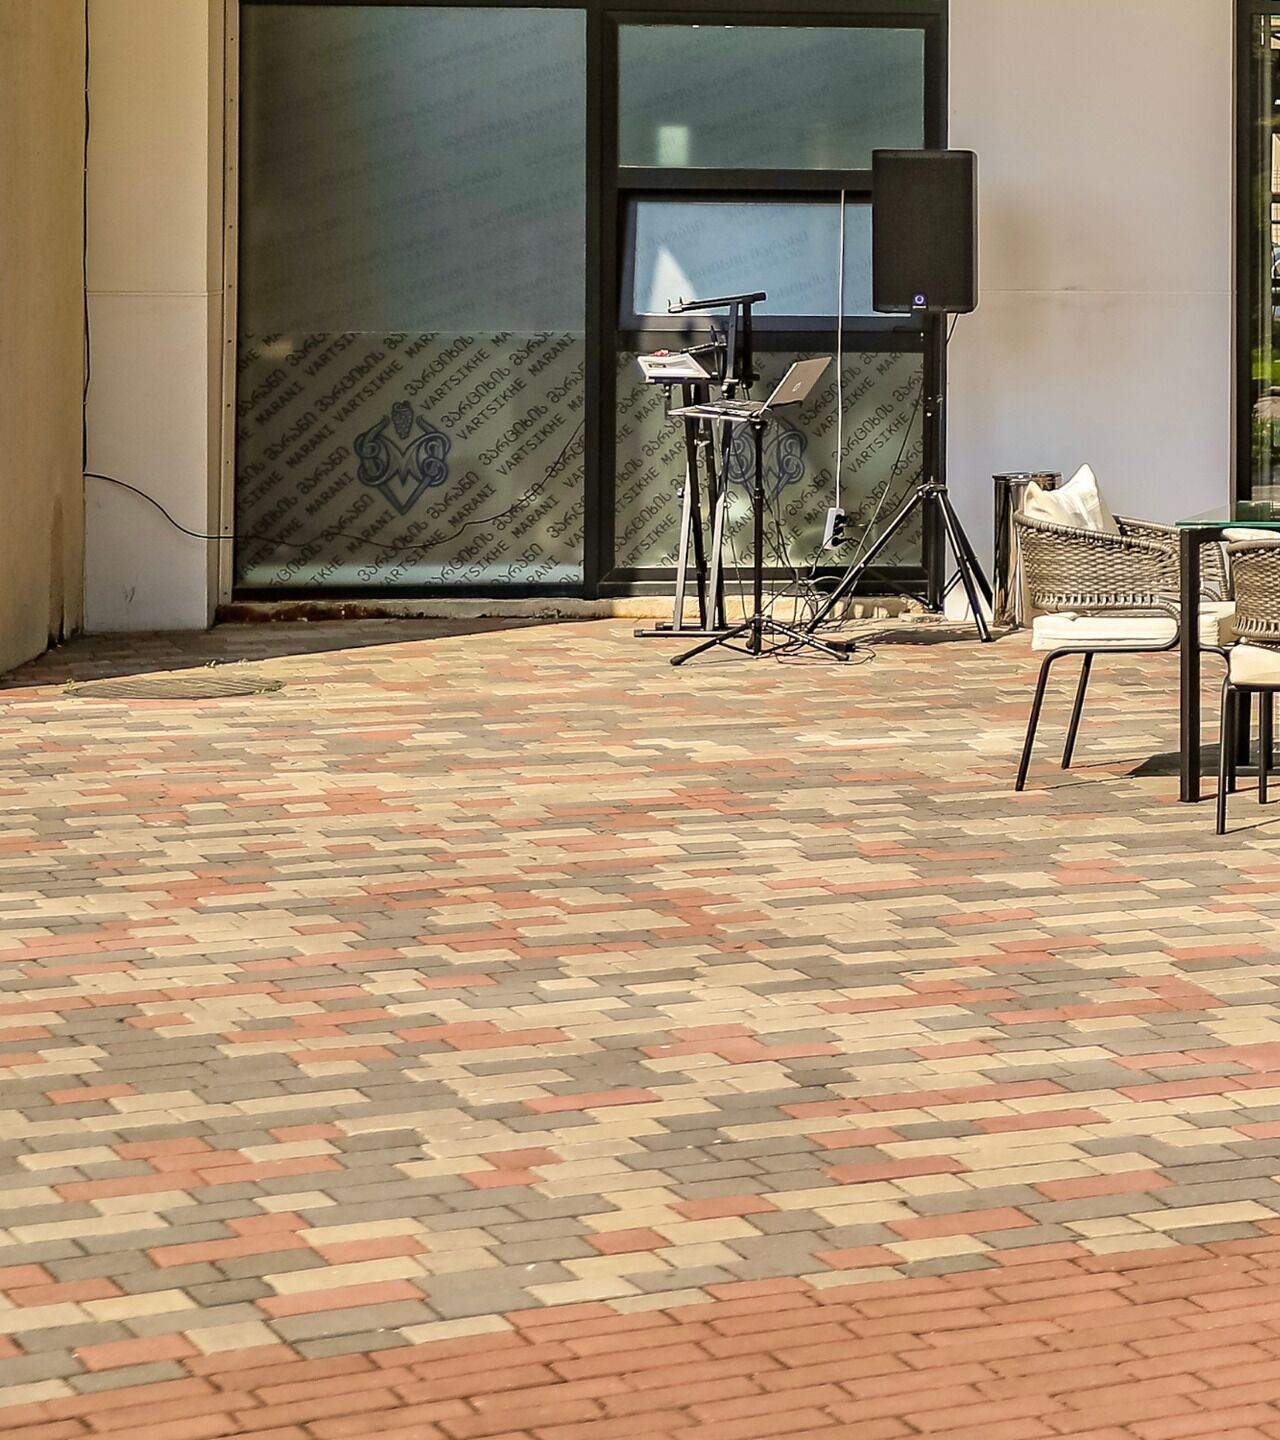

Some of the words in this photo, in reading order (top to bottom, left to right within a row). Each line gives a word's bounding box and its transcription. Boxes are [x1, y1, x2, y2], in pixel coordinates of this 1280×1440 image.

[403, 336, 475, 397] ვარციხის
[420, 348, 490, 411] VARTSIKHE
[456, 377, 527, 440] VARTSIKHE
[528, 332, 577, 377] MARANI
[255, 381, 305, 425] MARANI
[263, 411, 318, 461] მარანი
[314, 352, 386, 413] ვარციხის
[285, 424, 335, 469] MARANI
[333, 359, 404, 422] VARTSIKHE
[440, 367, 511, 428] ვარციხის
[478, 405, 549, 466] ვარციხის
[495, 412, 566, 476] VARTSIKHE
[843, 411, 913, 473] VARTSIKHE
[296, 446, 350, 495] მარანი
[305, 471, 354, 516] MARANI
[785, 468, 833, 517] მარანი
[346, 510, 395, 554] MARANI
[357, 521, 429, 582] ვარციხის
[426, 471, 480, 520] მარანი
[448, 484, 497, 528] MARANI
[511, 495, 560, 539] MARANI
[719, 507, 758, 545] ARANI
